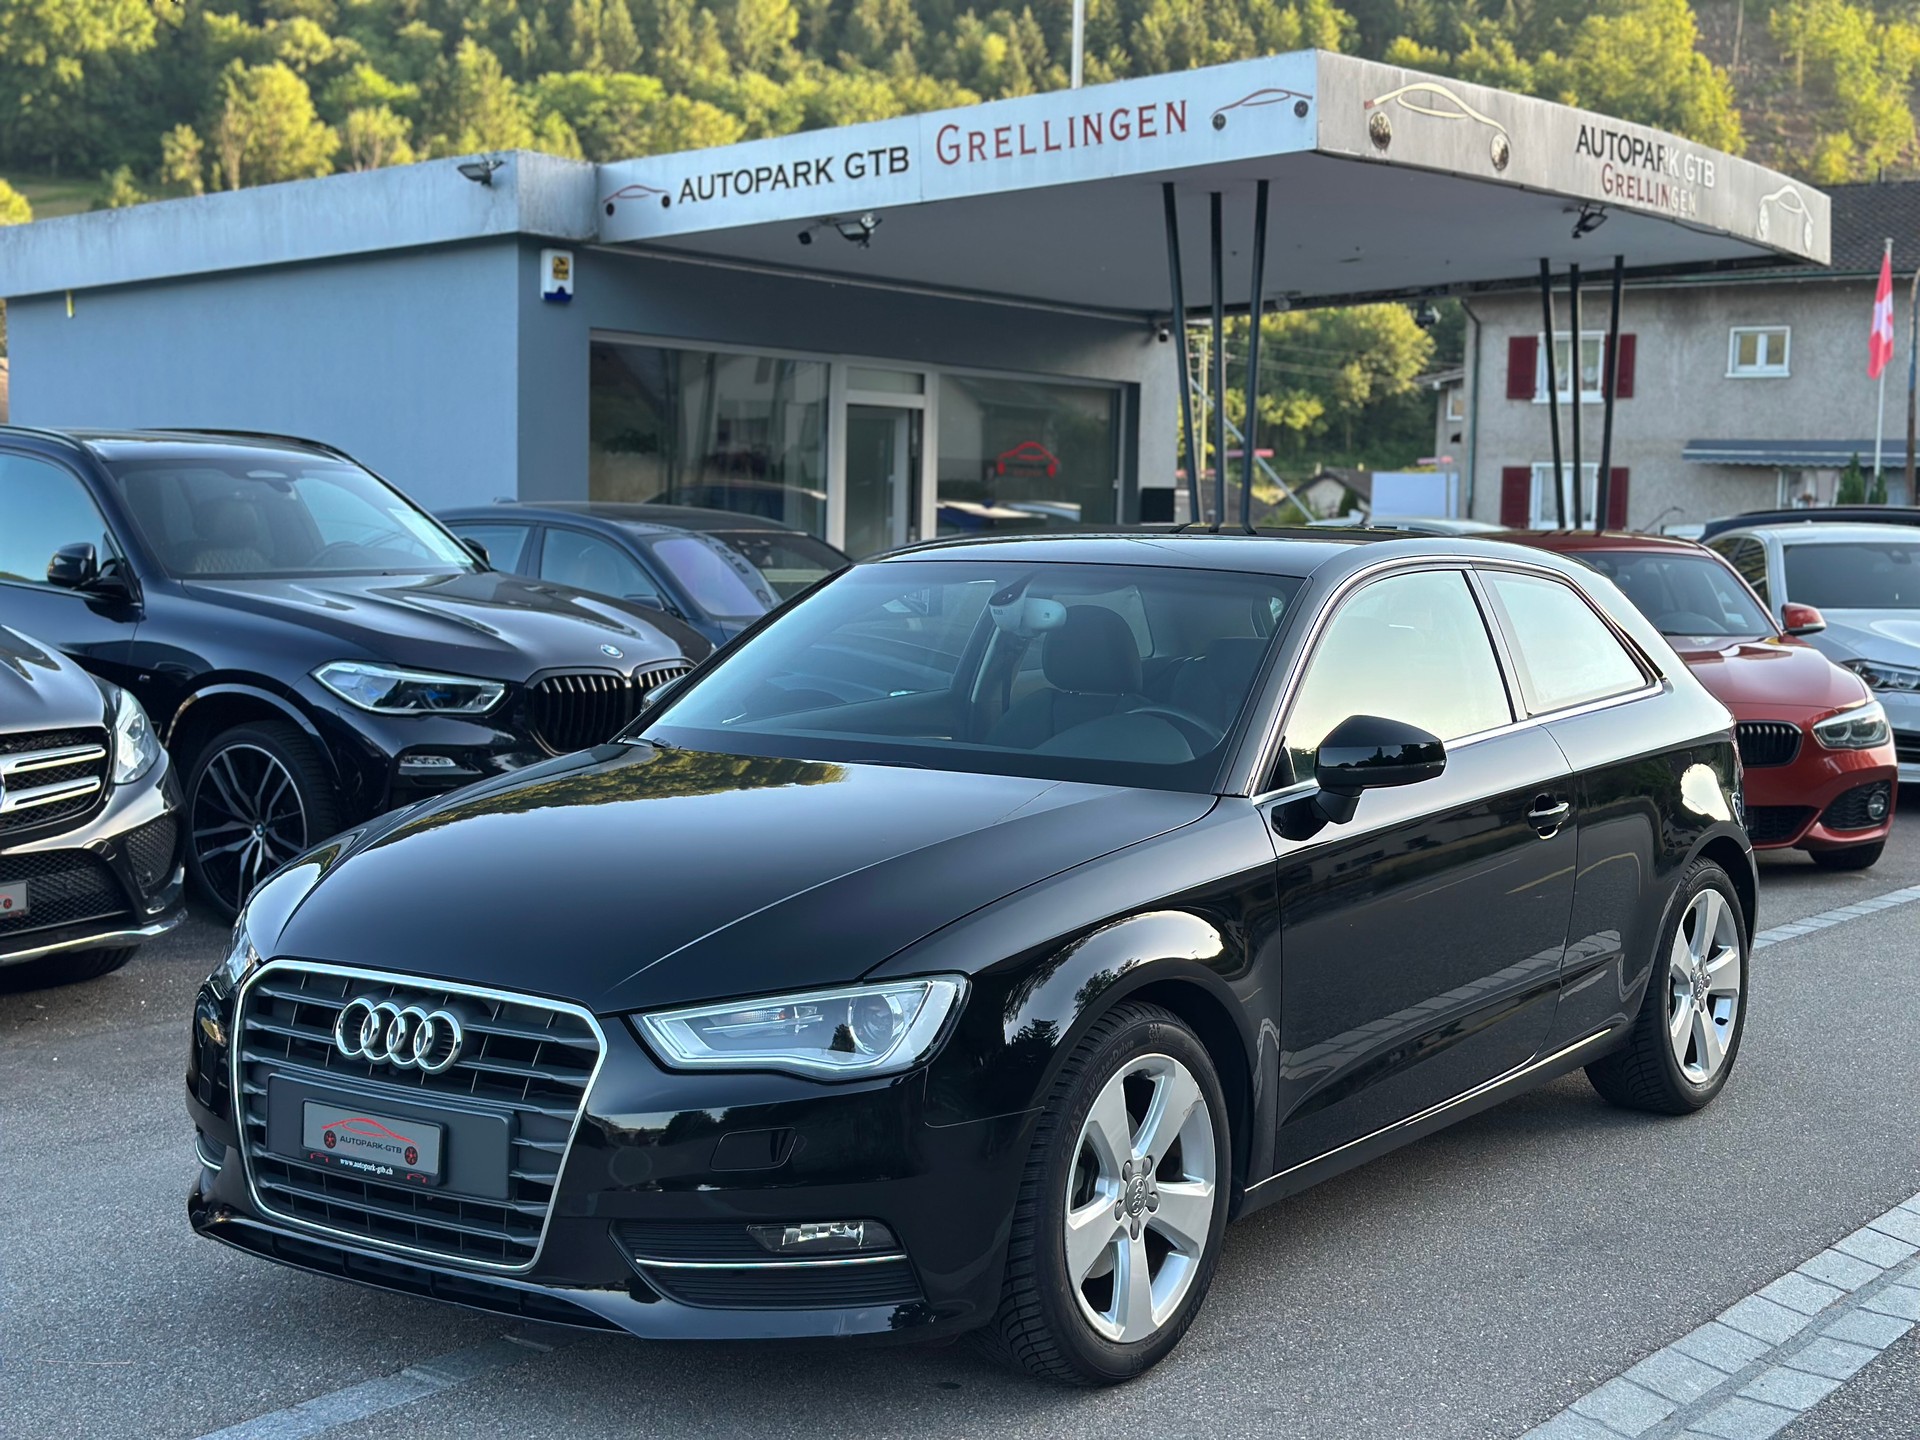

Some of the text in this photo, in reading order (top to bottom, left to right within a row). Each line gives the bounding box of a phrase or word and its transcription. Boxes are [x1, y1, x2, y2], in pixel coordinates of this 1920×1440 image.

[936, 100, 1187, 165] GRELLINGEN
[1575, 124, 1715, 189] AUTOPARK GTB
[678, 145, 909, 204] AUTOPARK GTB
[1602, 163, 1696, 215] GRELLINGEN
[340, 1135, 402, 1154] AUTOPARK-GTB
